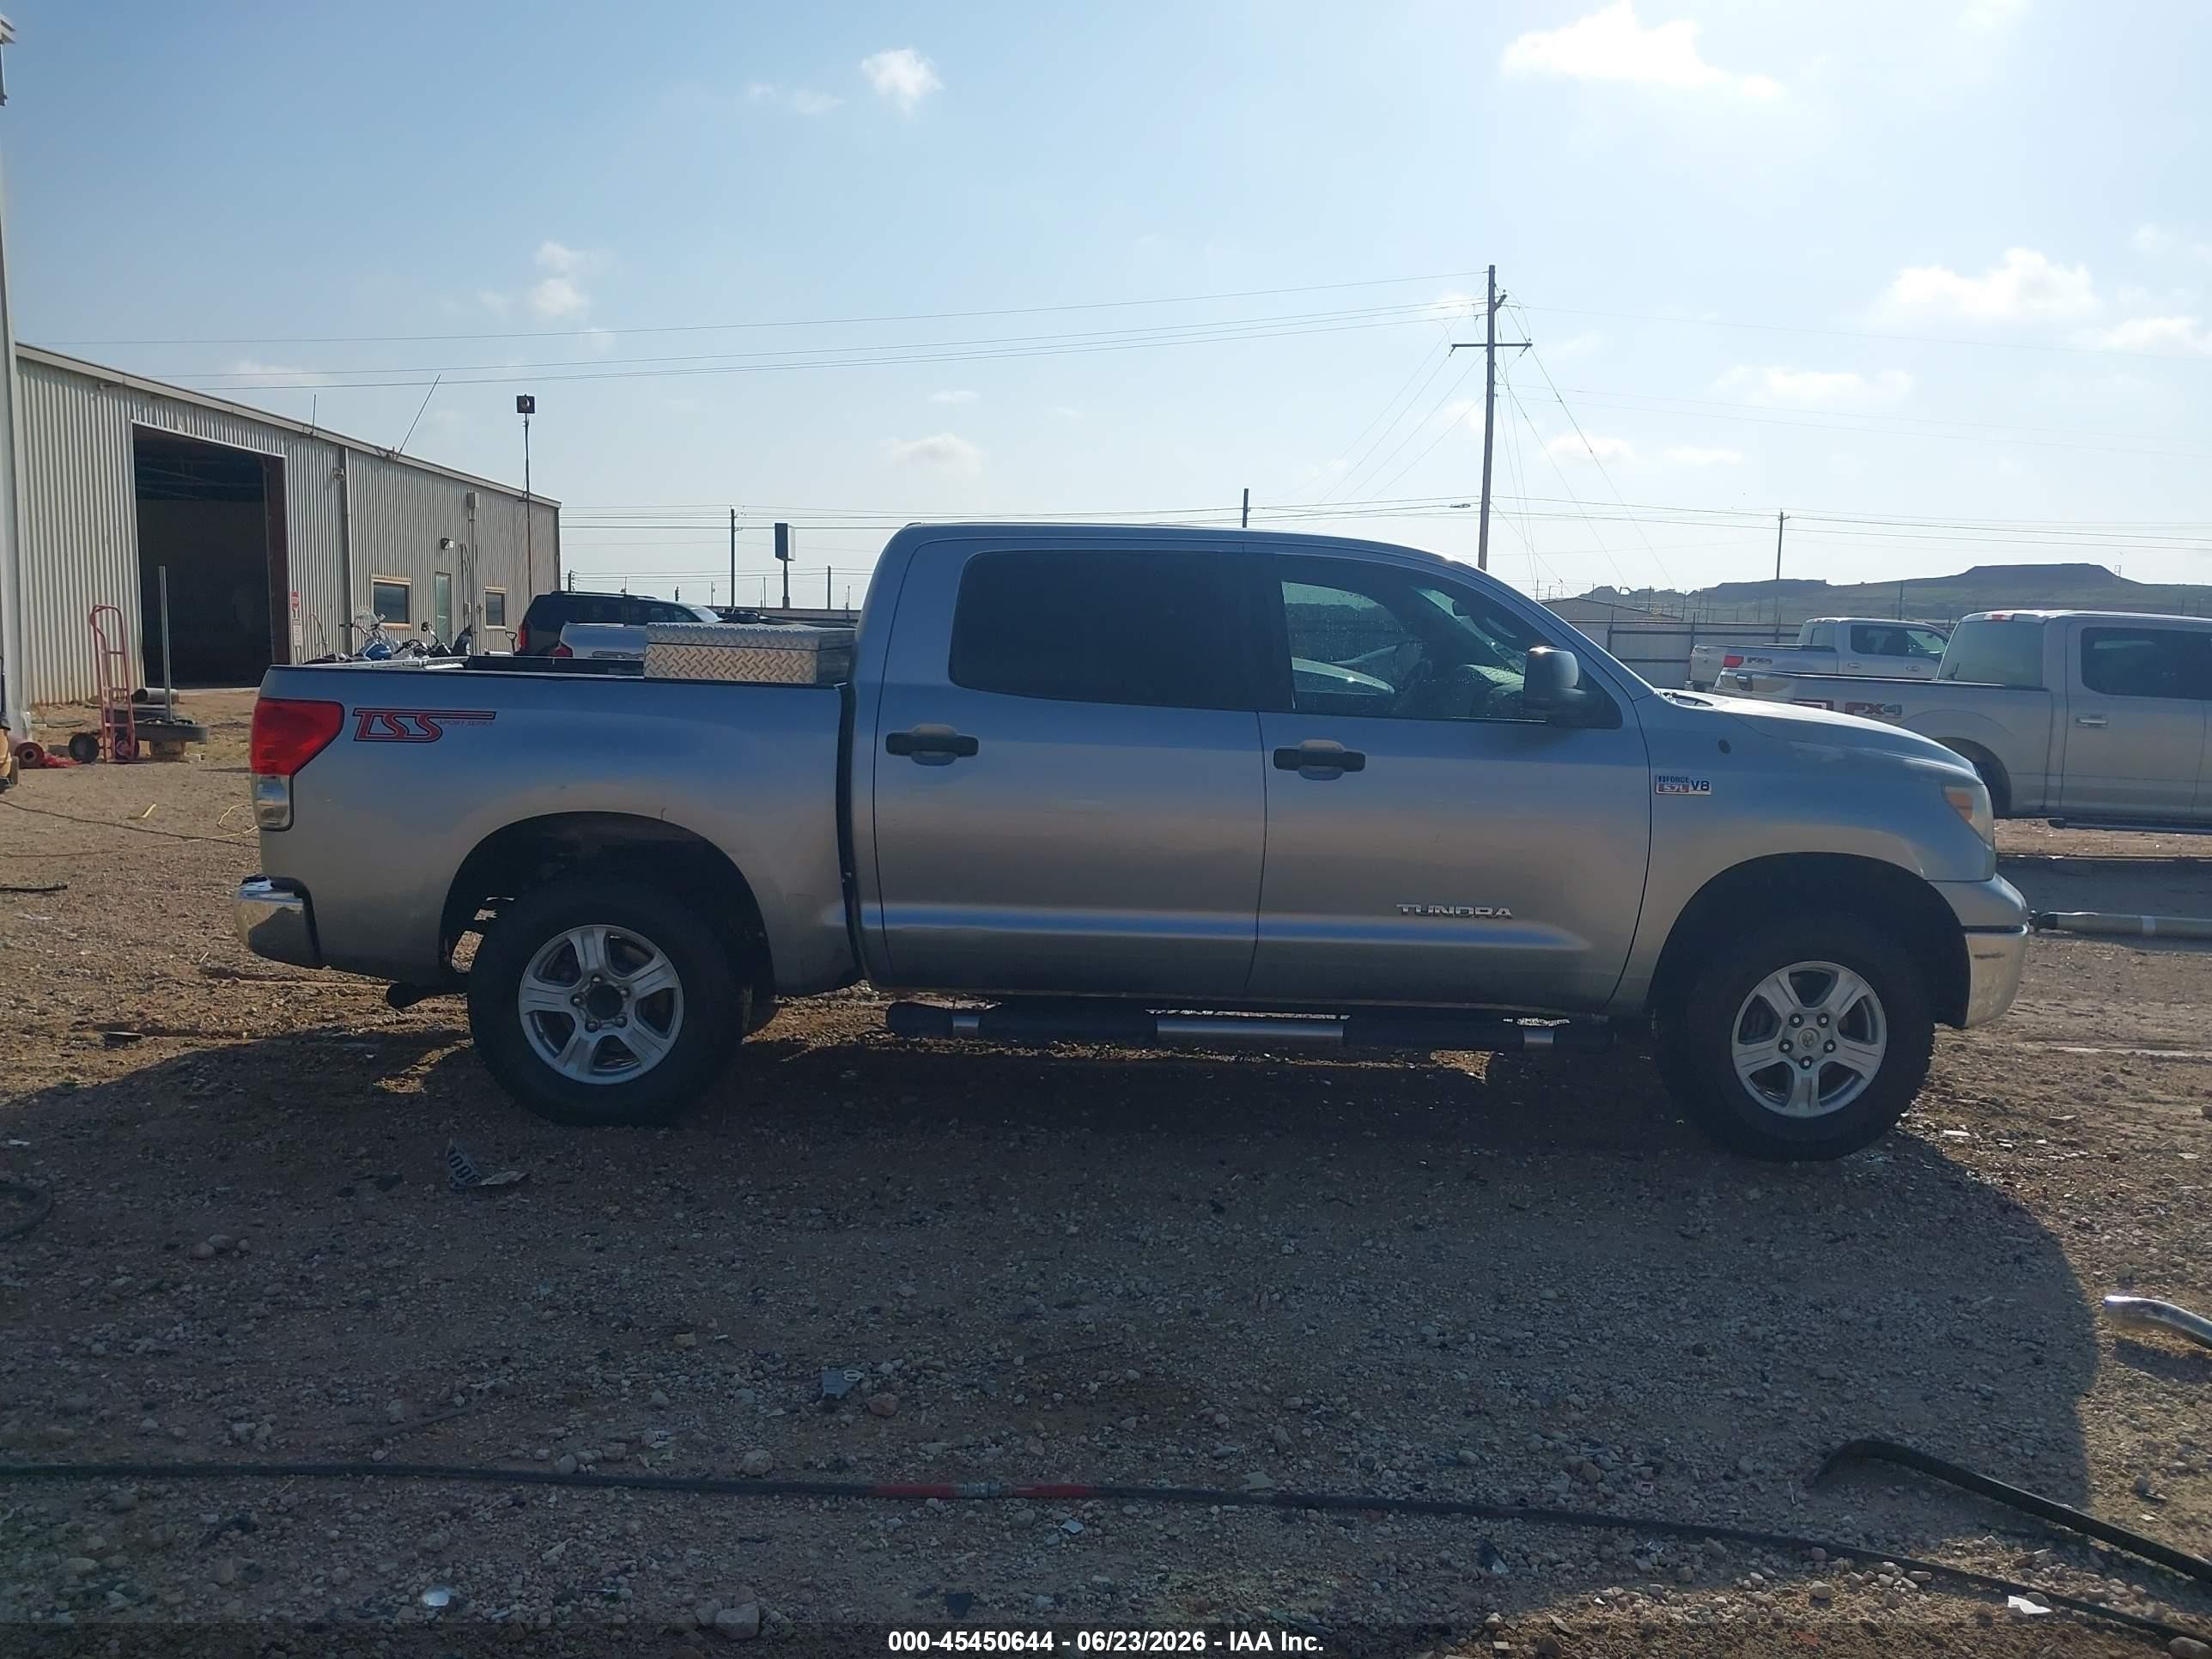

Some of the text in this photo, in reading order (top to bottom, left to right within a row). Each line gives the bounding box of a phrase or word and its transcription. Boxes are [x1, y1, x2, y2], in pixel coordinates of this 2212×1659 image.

[1845, 702, 1903, 716] FX4
[353, 708, 495, 743] TSS
[1691, 780, 1710, 791] V8
[1396, 903, 1512, 919] TUNDRA
